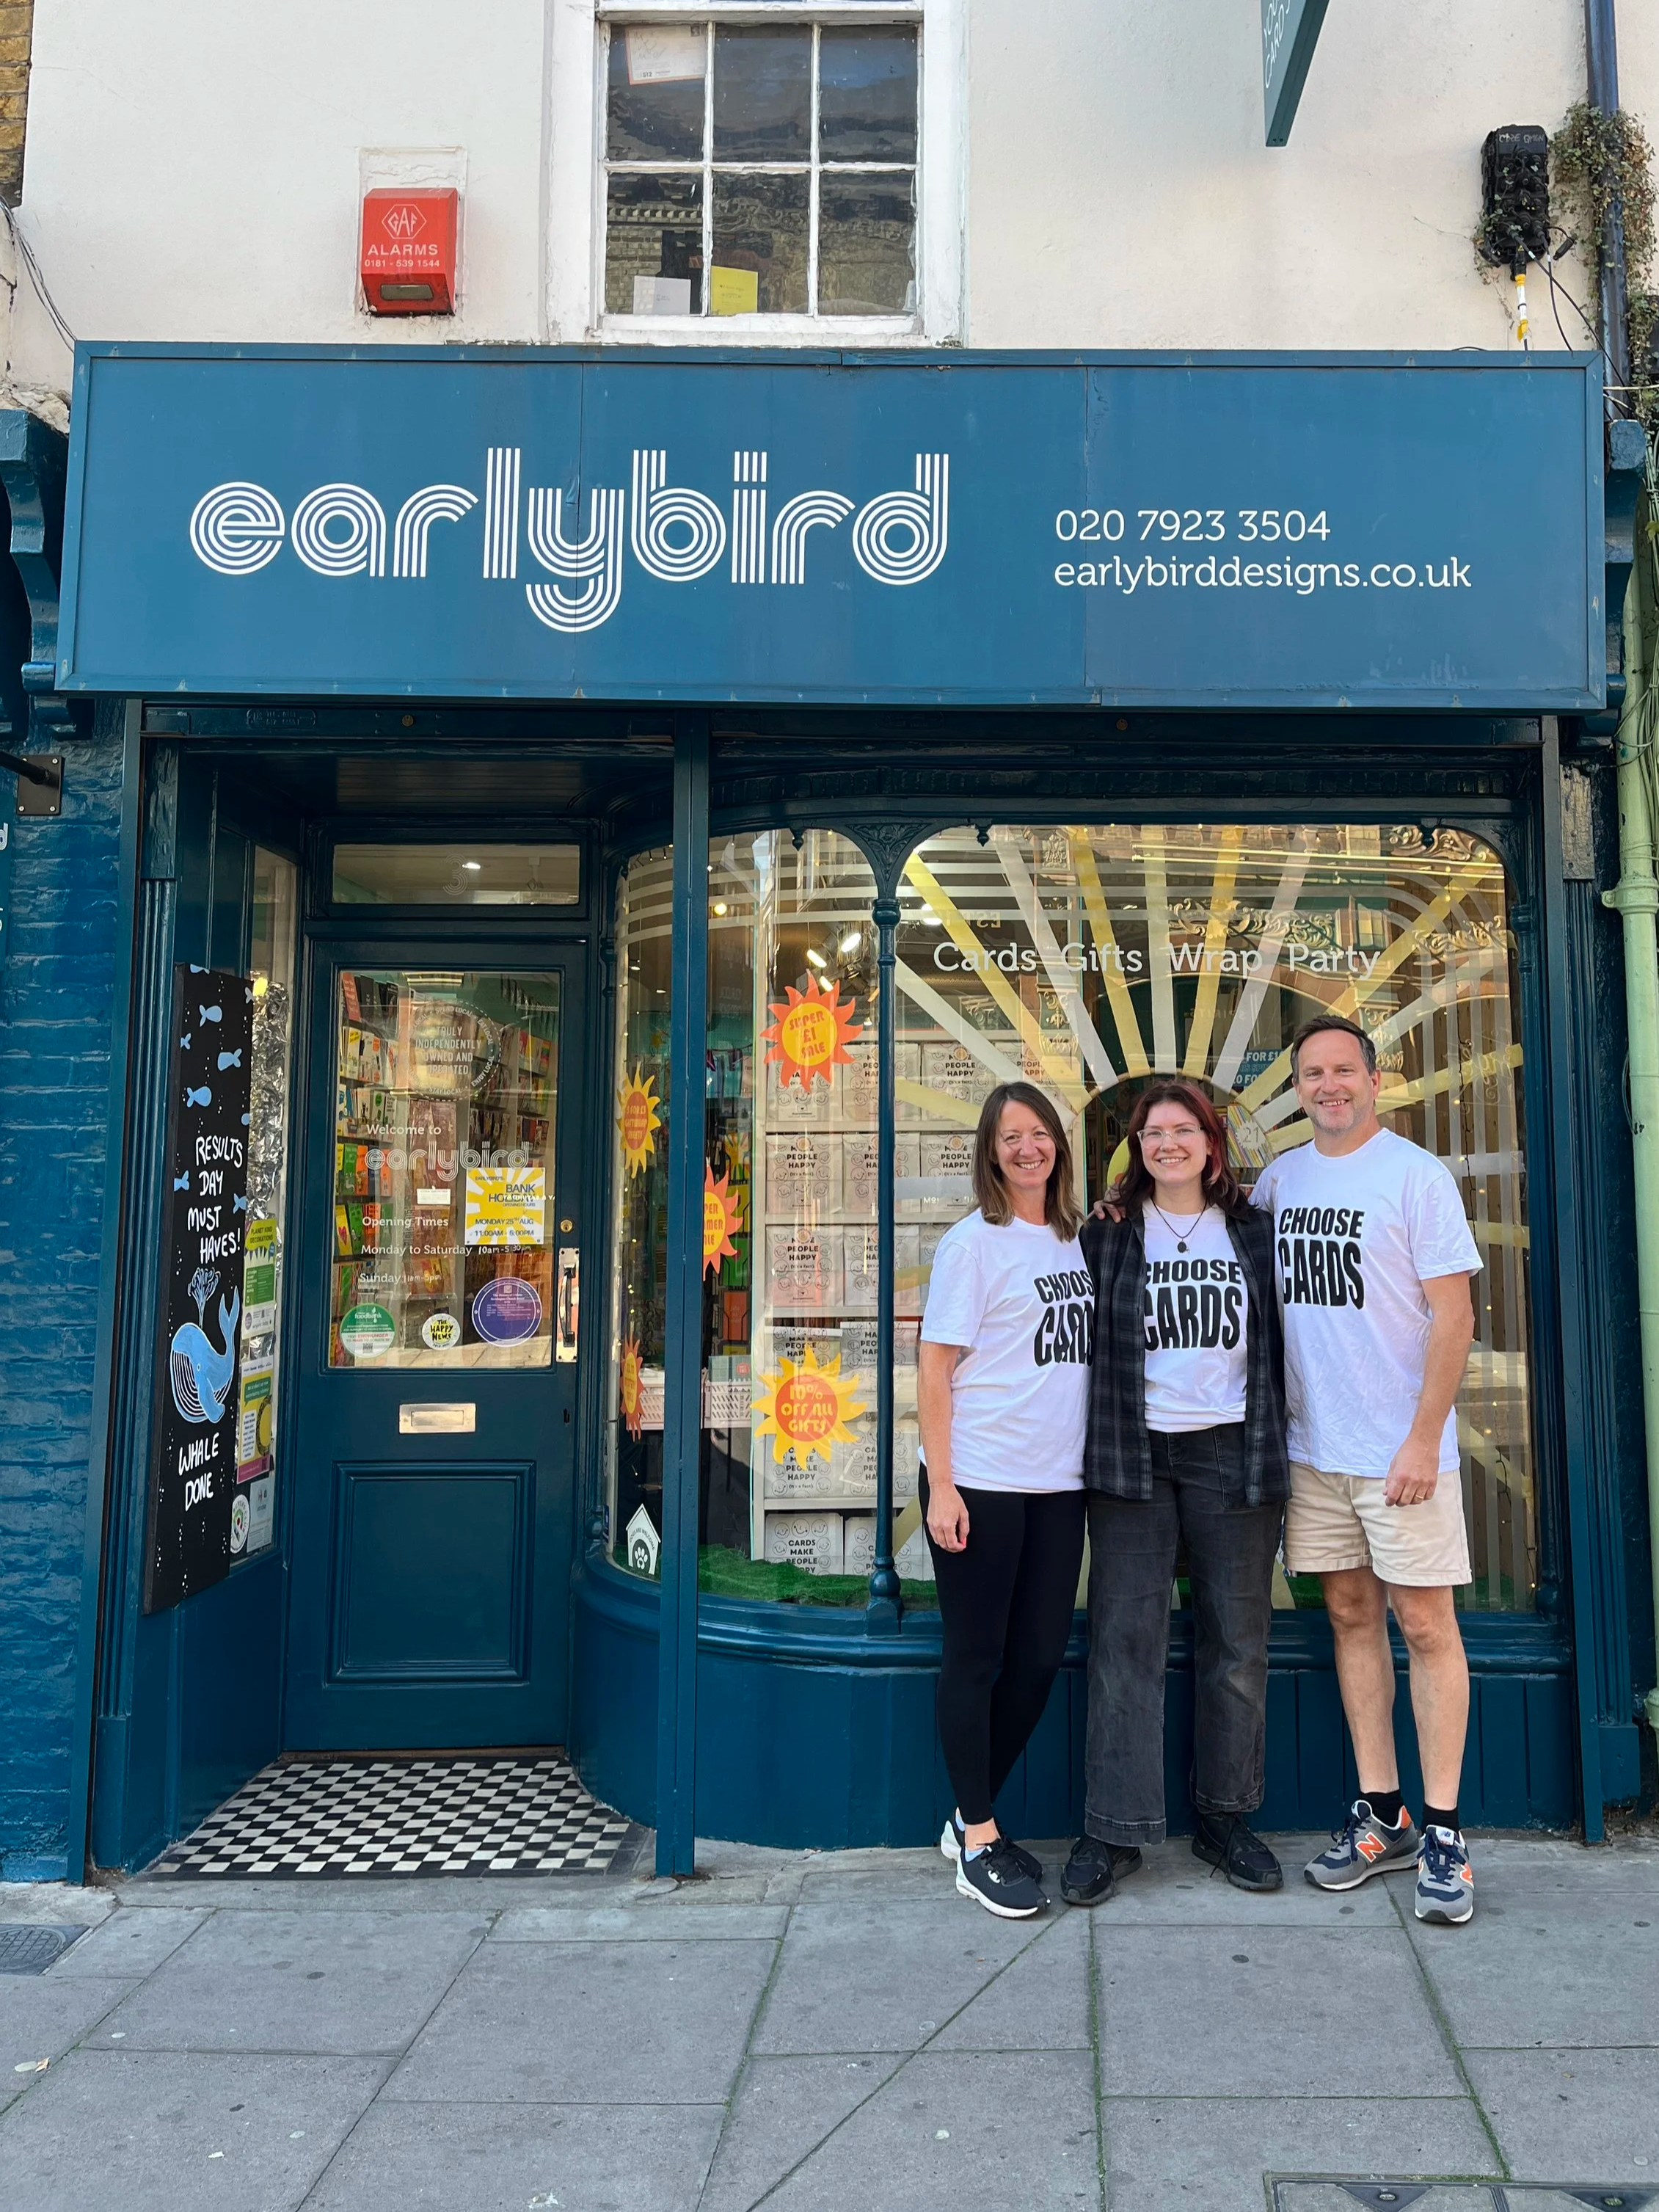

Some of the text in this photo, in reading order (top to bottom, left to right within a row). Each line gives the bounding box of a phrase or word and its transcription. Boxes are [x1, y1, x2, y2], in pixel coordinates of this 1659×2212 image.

[387, 207, 418, 236] GAF
[367, 244, 438, 255] ALARMS
[1055, 509, 1332, 542] 020 7923 3504
[189, 447, 949, 633] earlybird
[1054, 556, 1473, 595] earlybirddesigns.co.uk
[933, 942, 1381, 980] Cards Gifts Wrap Party
[455, 1007, 472, 1017] LOCAL
[789, 1011, 825, 1030] SUPER
[437, 1027, 462, 1036] TRULY
[477, 1019, 493, 1045] EAT LOCAL
[803, 1027, 817, 1044] £1
[415, 1039, 482, 1049] INDEPENDENTLY
[801, 1041, 825, 1059] SALE
[456, 1052, 473, 1062] AND
[1246, 1052, 1266, 1062] FOR
[471, 1055, 495, 1087] ENJOY LOCAL
[1244, 1074, 1260, 1084] FO
[366, 1124, 442, 1135] Welcome to
[1243, 1127, 1259, 1143] 21
[196, 1136, 243, 1168] RESULTS
[365, 1140, 530, 1182] earlybird
[200, 1170, 224, 1197] DAY
[506, 1184, 536, 1193] BANK
[188, 1205, 222, 1231] MUST
[362, 1216, 449, 1228] Opening Times
[1278, 1207, 1365, 1239] CHOOSE
[200, 1227, 241, 1264] HAVES!
[361, 1245, 406, 1256] Monday
[409, 1246, 421, 1255] to
[425, 1245, 473, 1256] Saturday
[360, 1273, 401, 1284] Sunday
[1278, 1237, 1364, 1310] CARDS
[430, 1325, 453, 1333] HAPPY
[432, 1333, 451, 1341] NEWS
[790, 1384, 823, 1400] 10%
[781, 1402, 834, 1416] OFF ALL
[788, 1420, 827, 1433] GIFTS
[178, 1433, 219, 1477] WHALE
[185, 1472, 214, 1512] DONE
[642, 1528, 655, 1550] WELCOME
